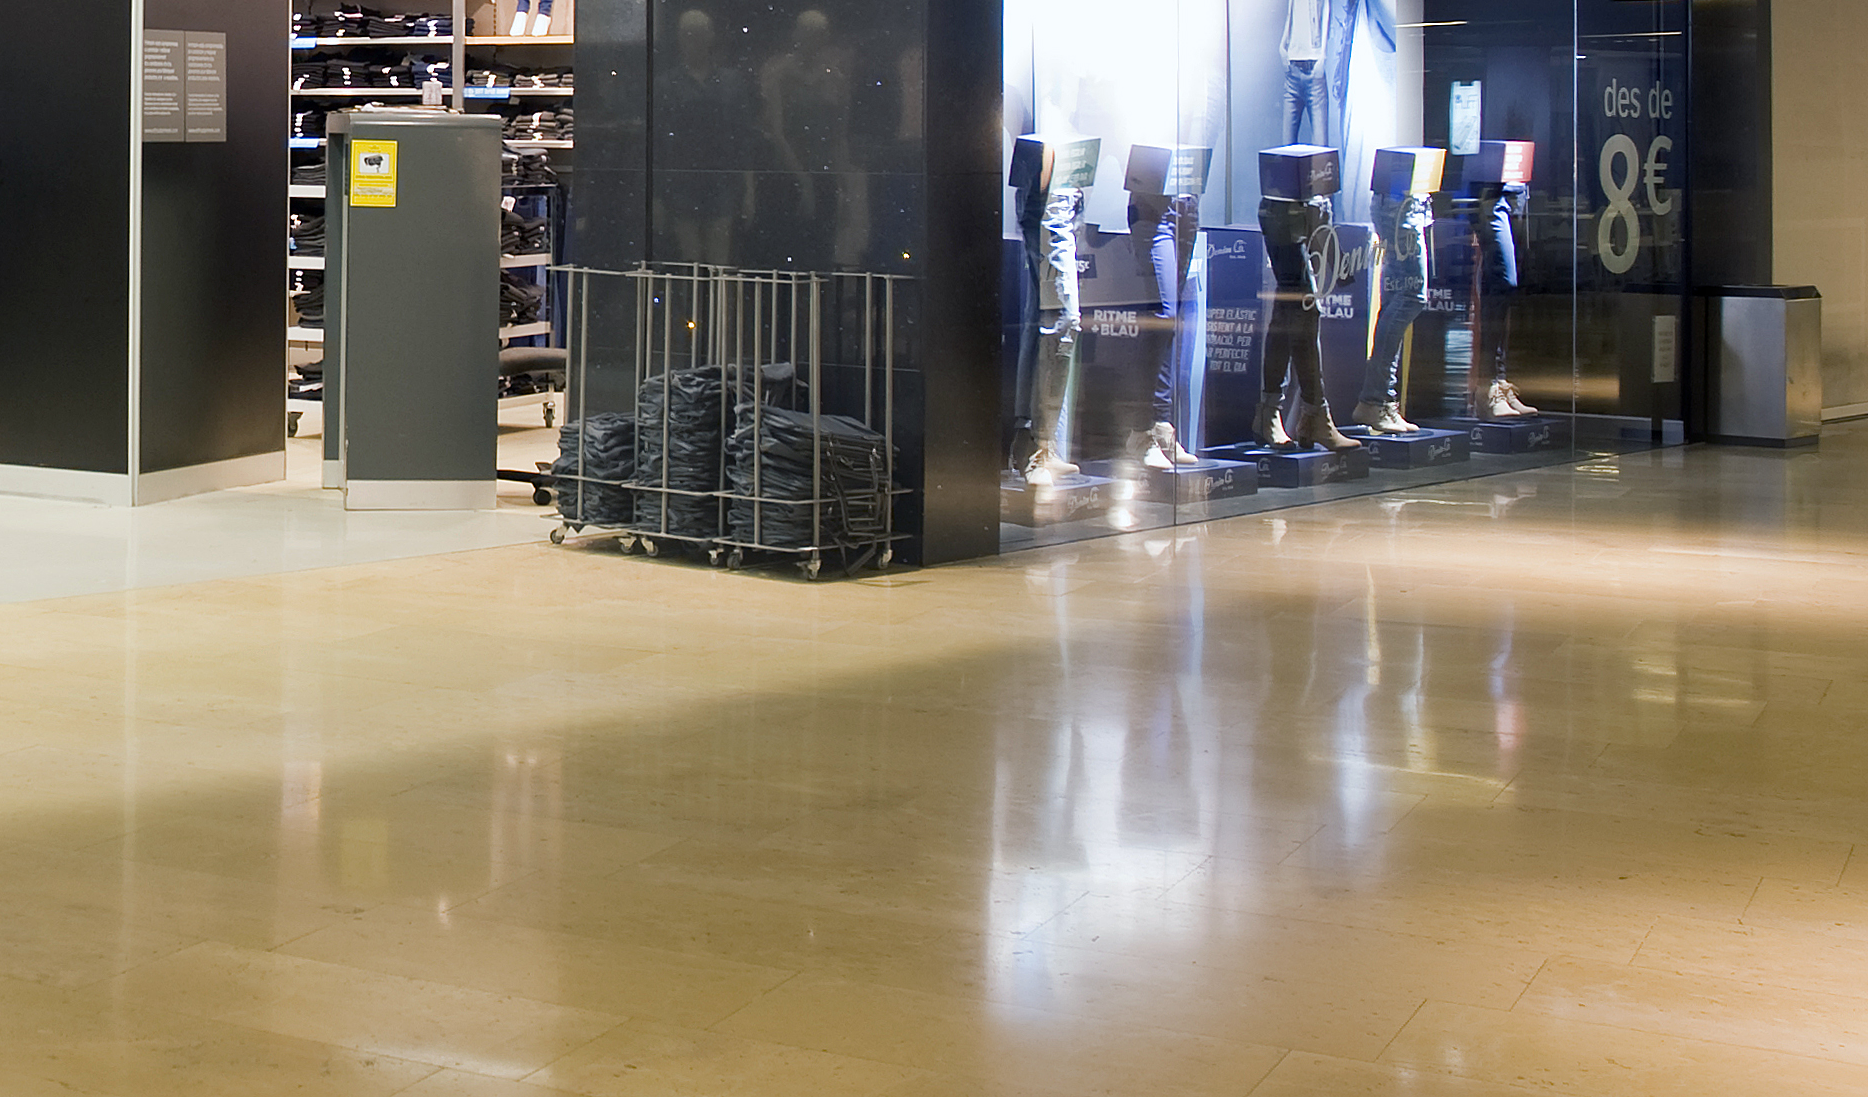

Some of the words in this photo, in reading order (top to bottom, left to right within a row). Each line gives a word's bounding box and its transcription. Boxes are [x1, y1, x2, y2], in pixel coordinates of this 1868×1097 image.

[1604, 77, 1642, 119] des
[1648, 80, 1674, 120] de
[1597, 133, 1673, 274] 8€
[1093, 309, 1137, 324] RITME
[1091, 323, 1140, 338] +BLAU
[1243, 322, 1254, 334] LA
